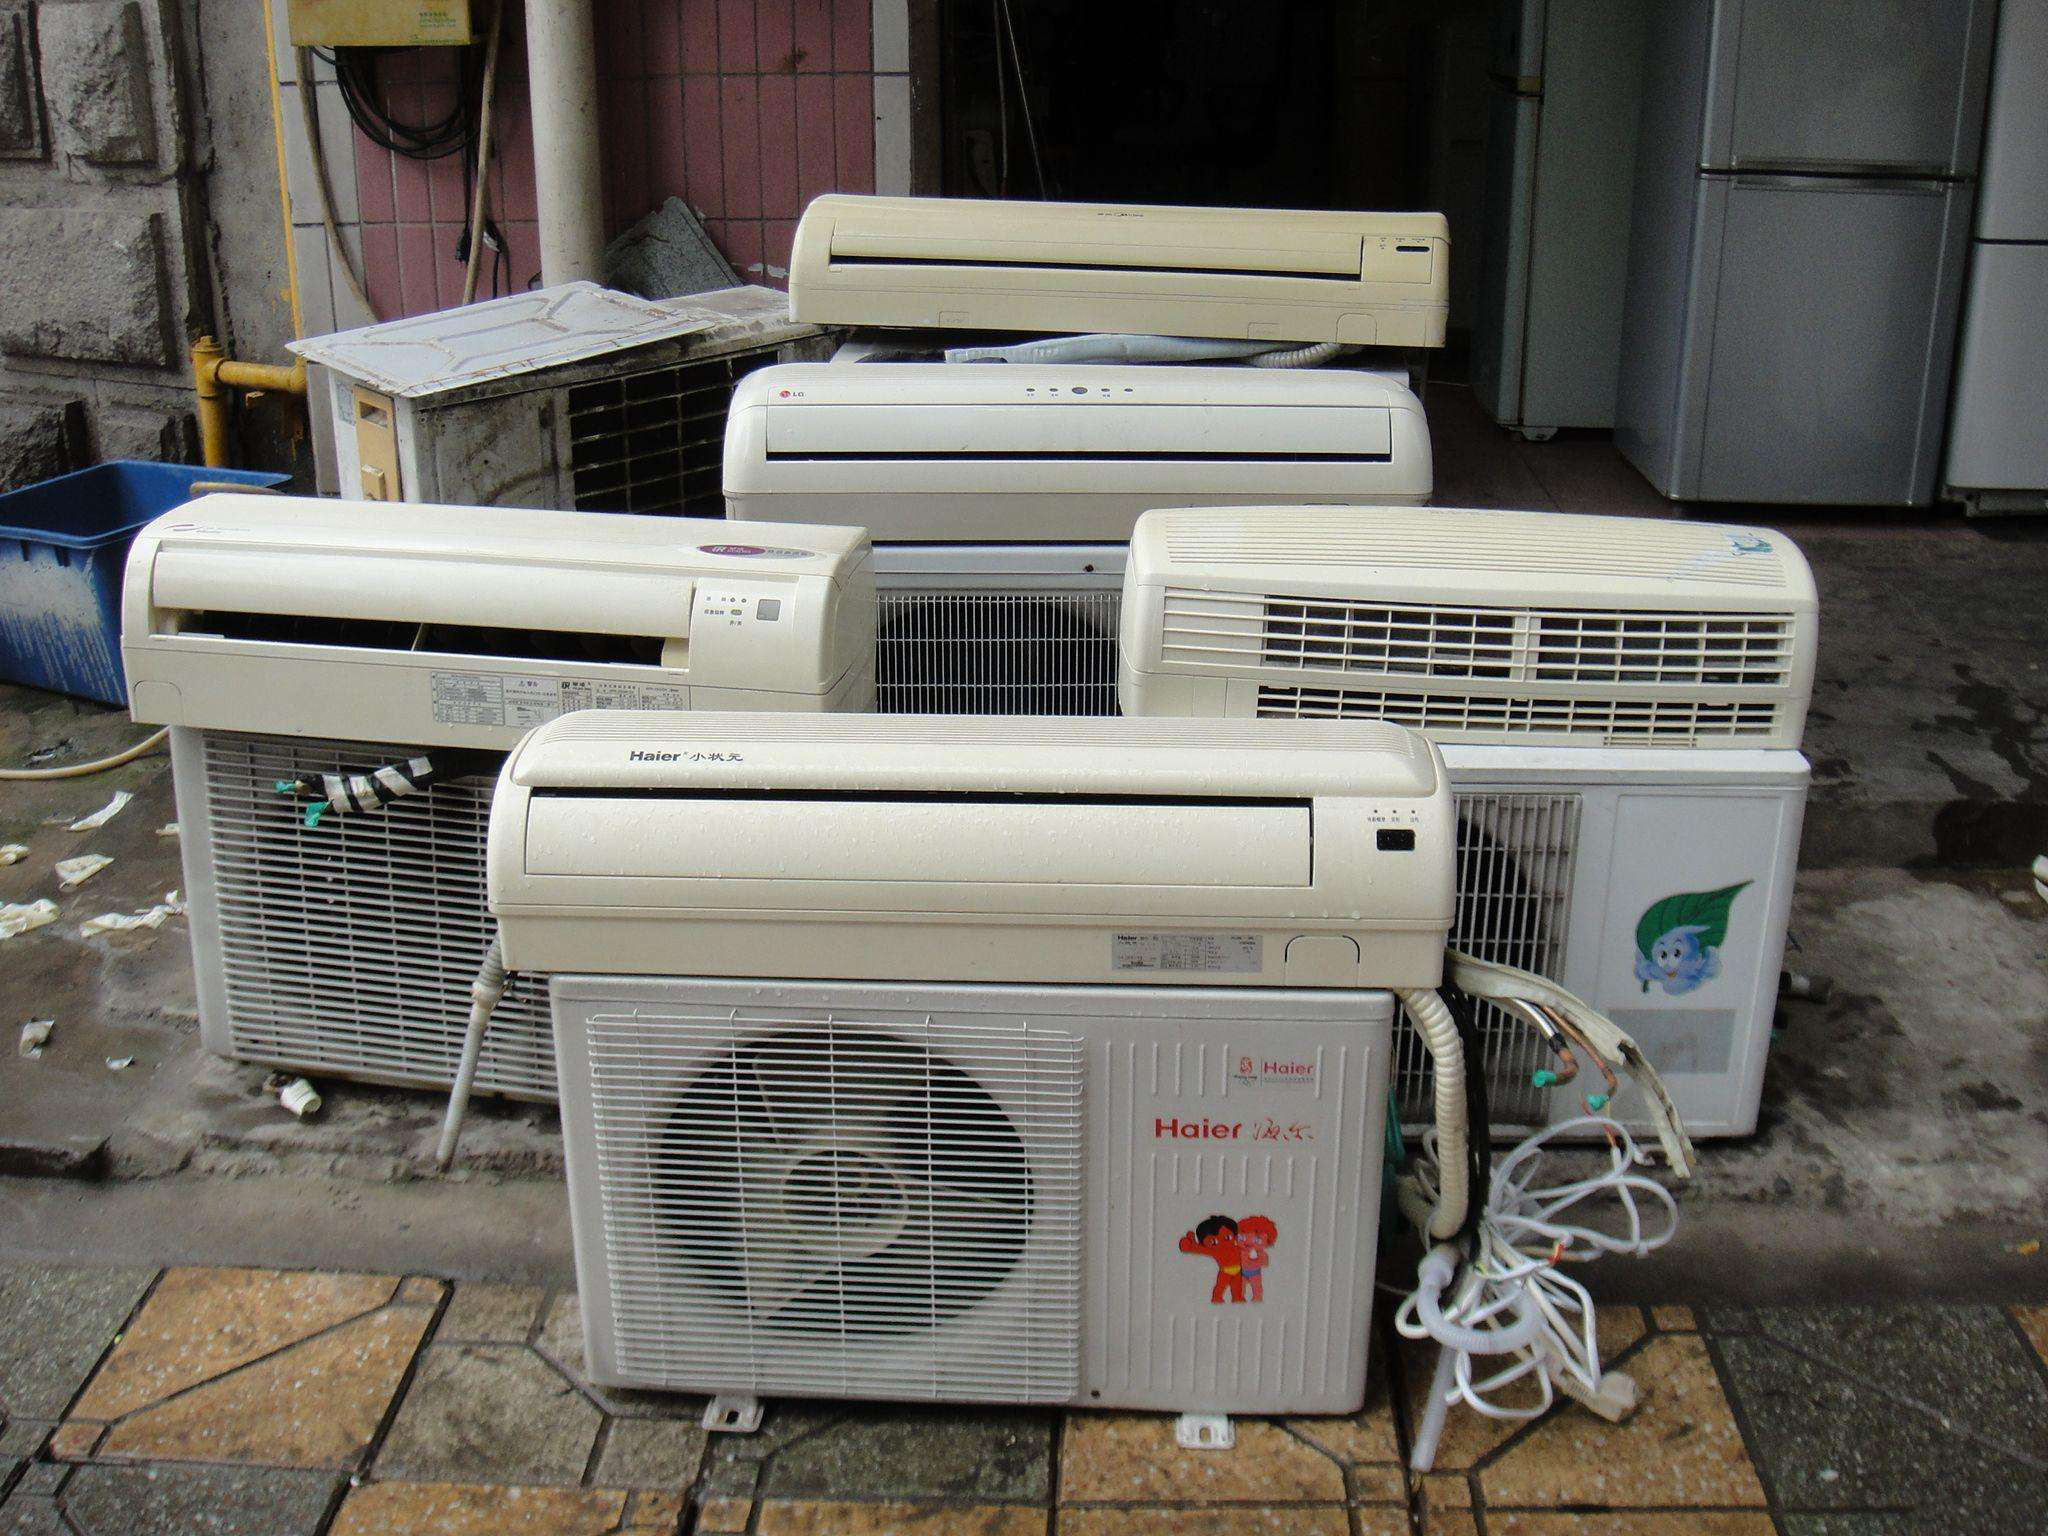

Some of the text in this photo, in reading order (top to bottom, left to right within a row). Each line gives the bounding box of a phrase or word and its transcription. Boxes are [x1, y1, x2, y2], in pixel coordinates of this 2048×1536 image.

[629, 750, 744, 762] Haier 小状元
[1263, 1061, 1315, 1075] Haier
[1154, 1118, 1243, 1140] Haier
